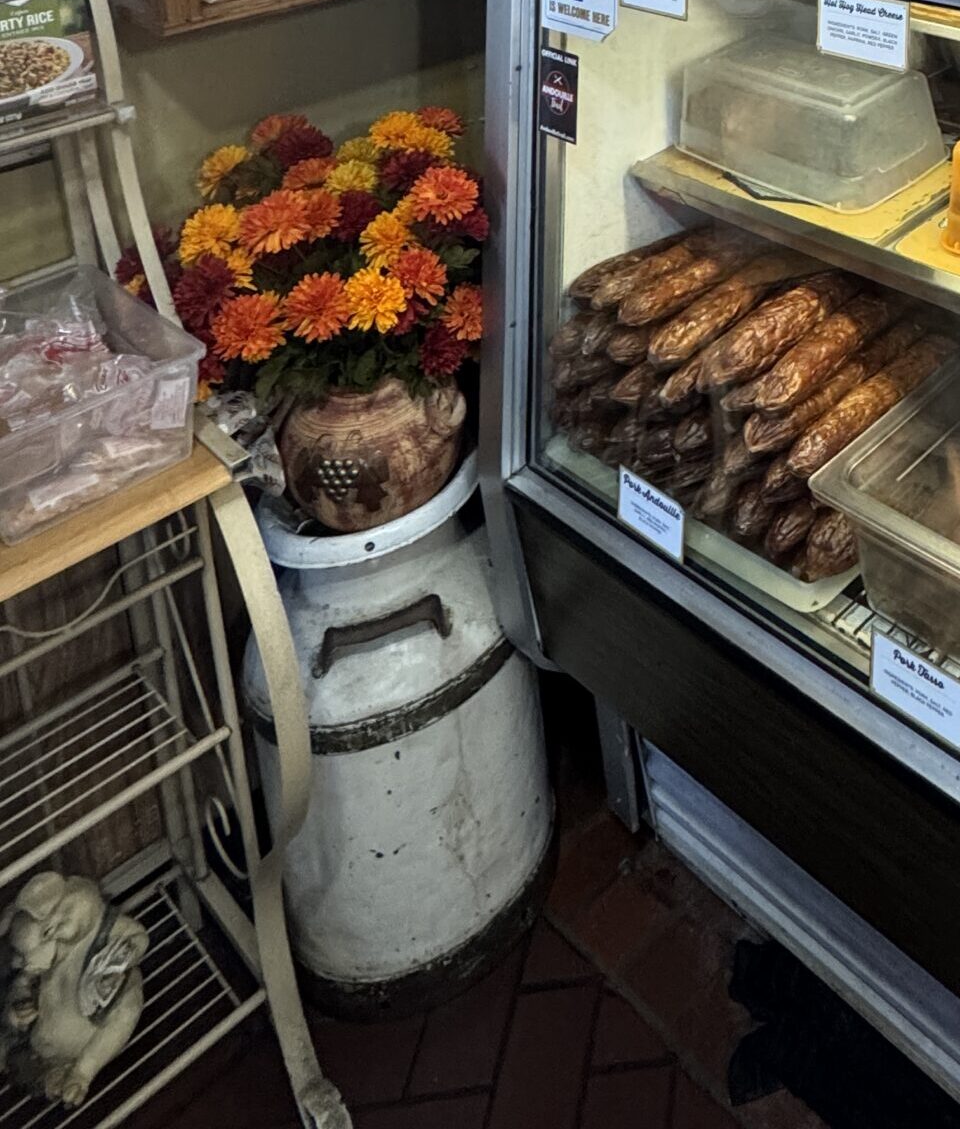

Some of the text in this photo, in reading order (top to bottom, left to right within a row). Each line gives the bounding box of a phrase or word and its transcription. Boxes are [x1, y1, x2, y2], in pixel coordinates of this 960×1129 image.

[0, 10, 54, 32] RTY RICE
[549, 0, 610, 27] IS WELCOME HERE
[624, 473, 641, 494] Pork
[642, 489, 681, 521] Andouille
[893, 649, 945, 689] Pork Tasso
